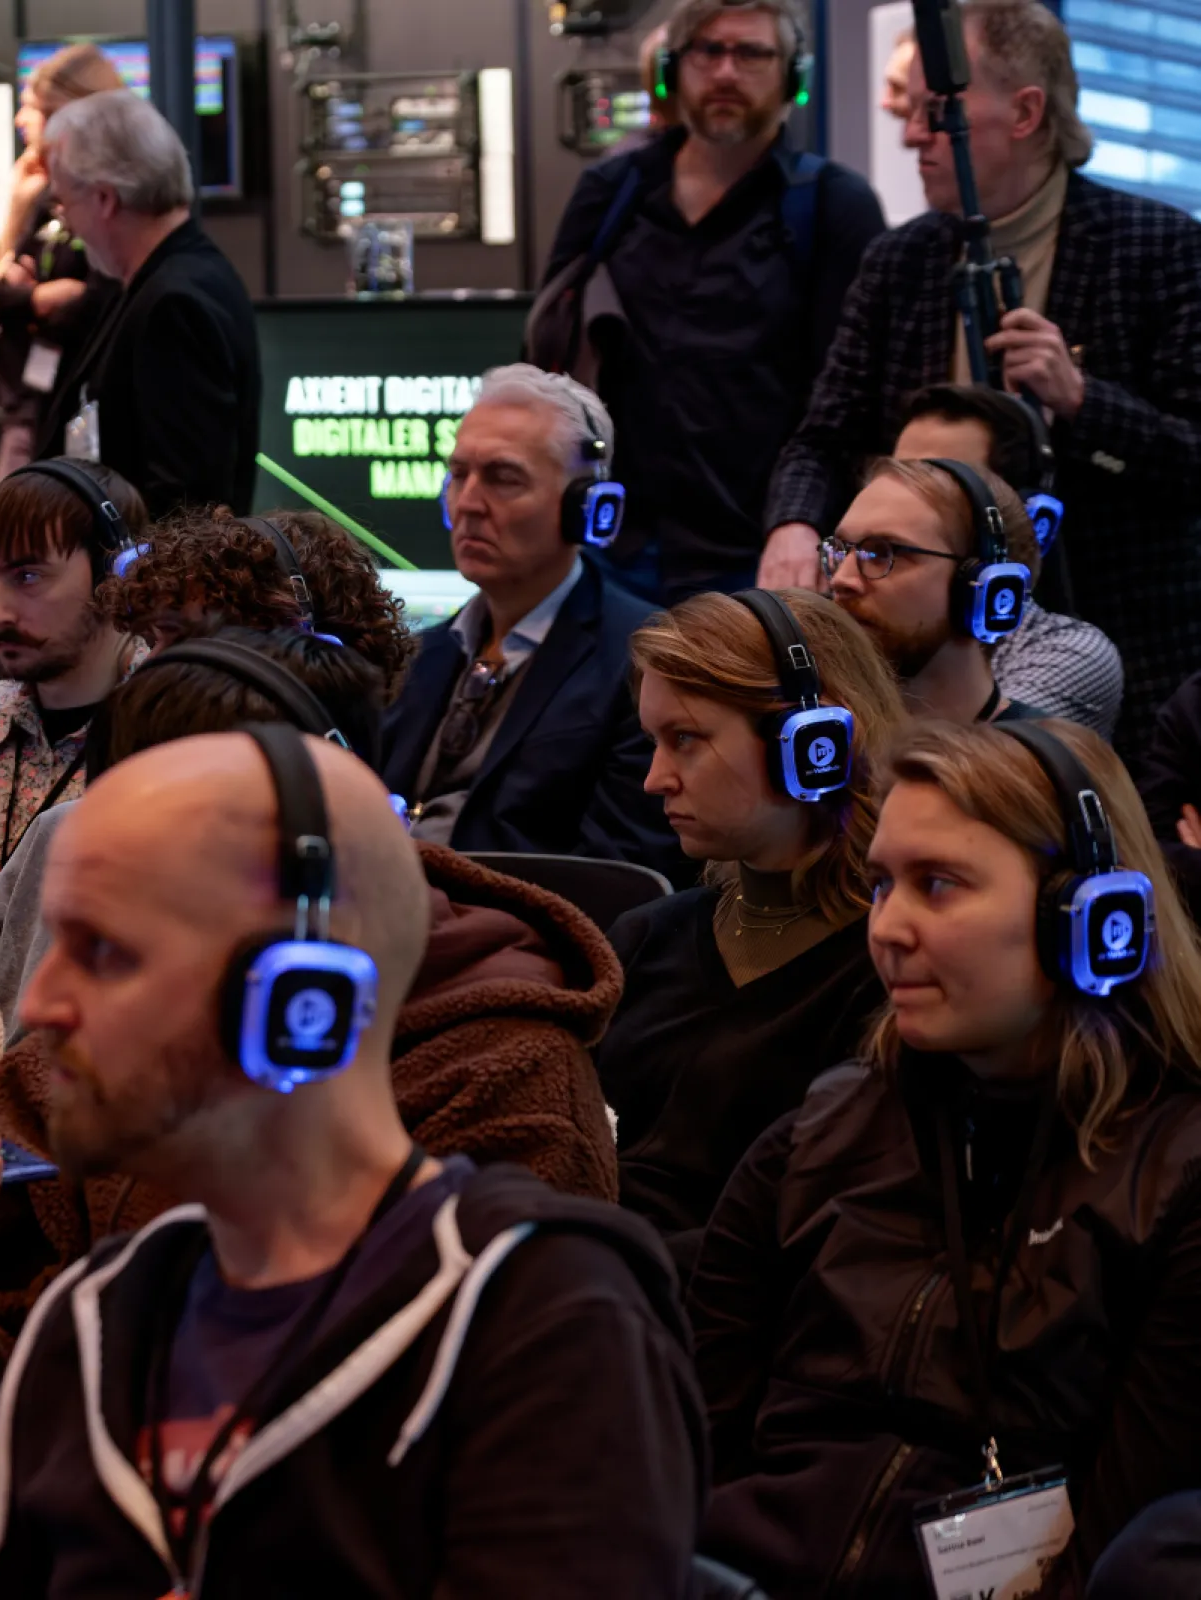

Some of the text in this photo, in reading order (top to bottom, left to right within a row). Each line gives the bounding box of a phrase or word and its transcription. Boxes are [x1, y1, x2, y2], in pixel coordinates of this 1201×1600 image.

[285, 376, 381, 415] AXIENT
[293, 418, 463, 457] DIGITALER S
